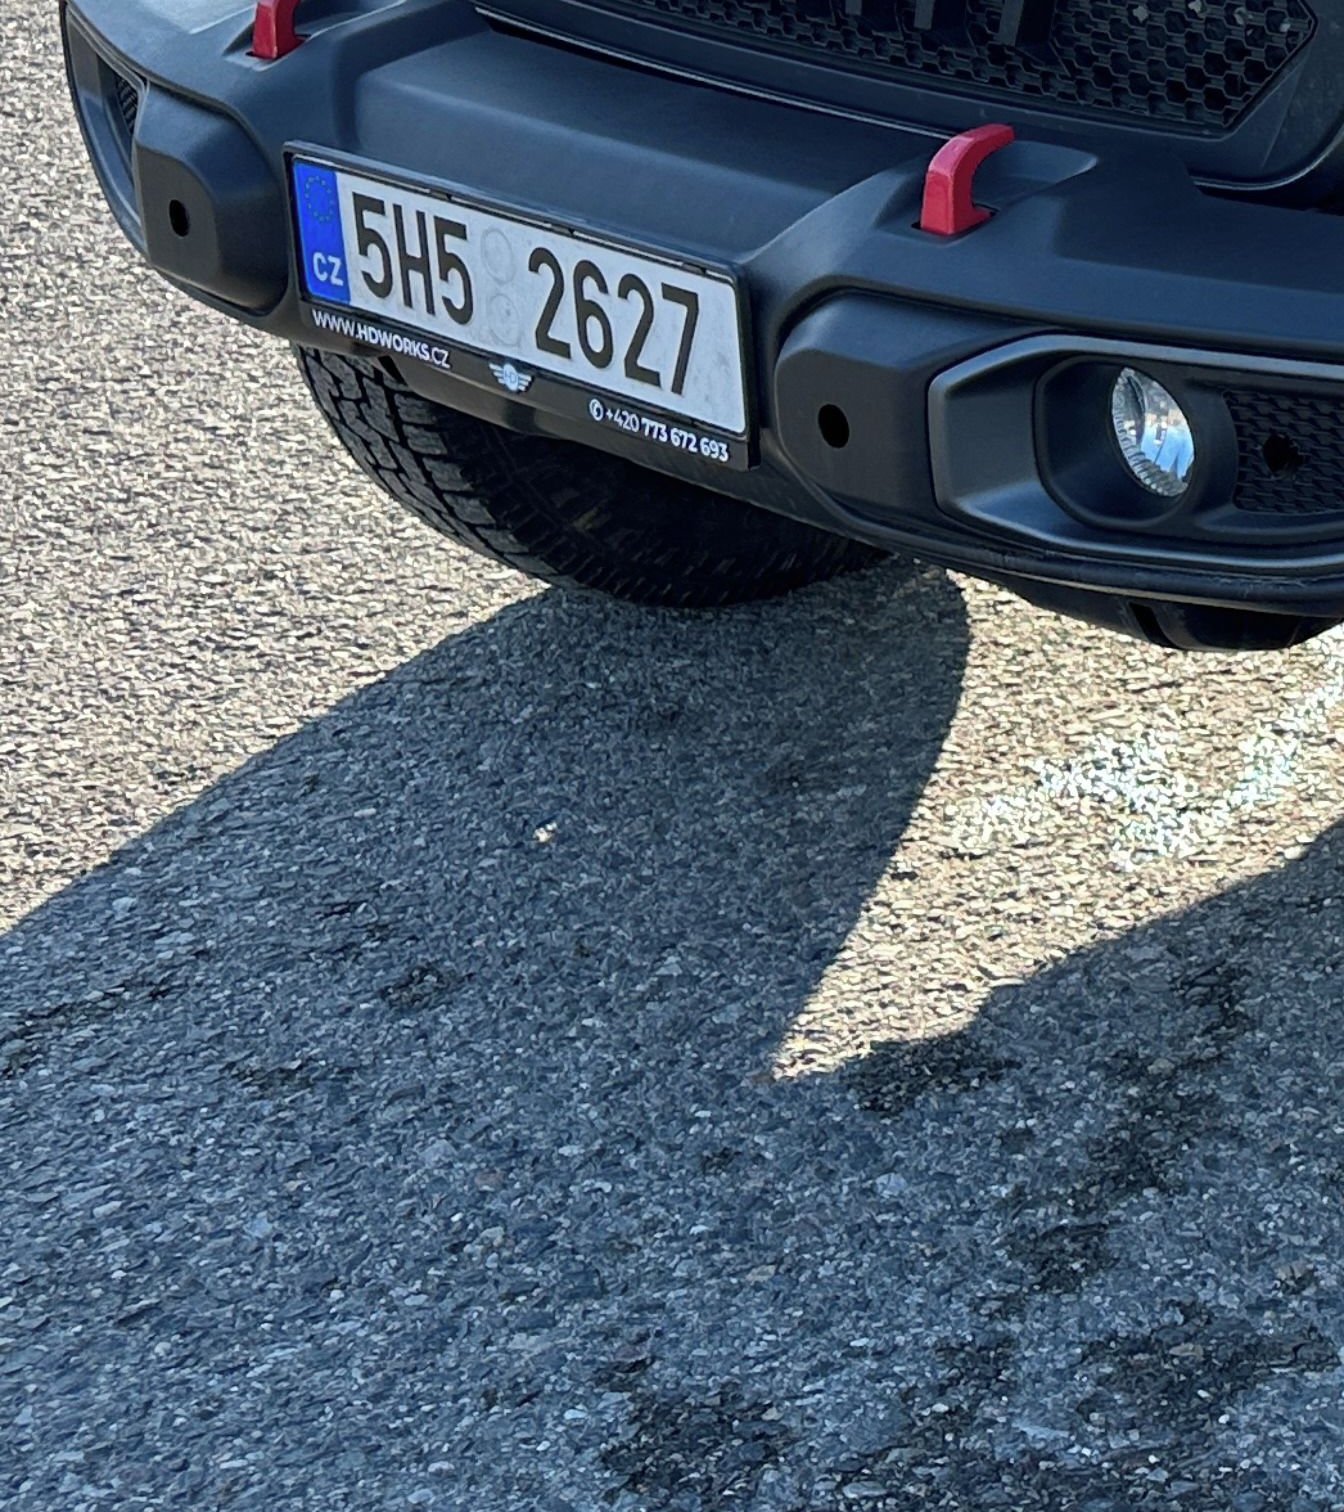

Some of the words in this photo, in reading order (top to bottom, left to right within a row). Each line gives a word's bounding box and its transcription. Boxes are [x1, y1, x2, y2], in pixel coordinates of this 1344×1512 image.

[312, 252, 343, 286] CZ
[352, 192, 474, 326] 5H5
[528, 246, 699, 396] 2627
[312, 310, 451, 369] WWW.HDWORKS.CZ
[606, 409, 640, 434] +420
[641, 417, 669, 442] 773
[669, 428, 698, 454] 672
[700, 437, 729, 462] 693
